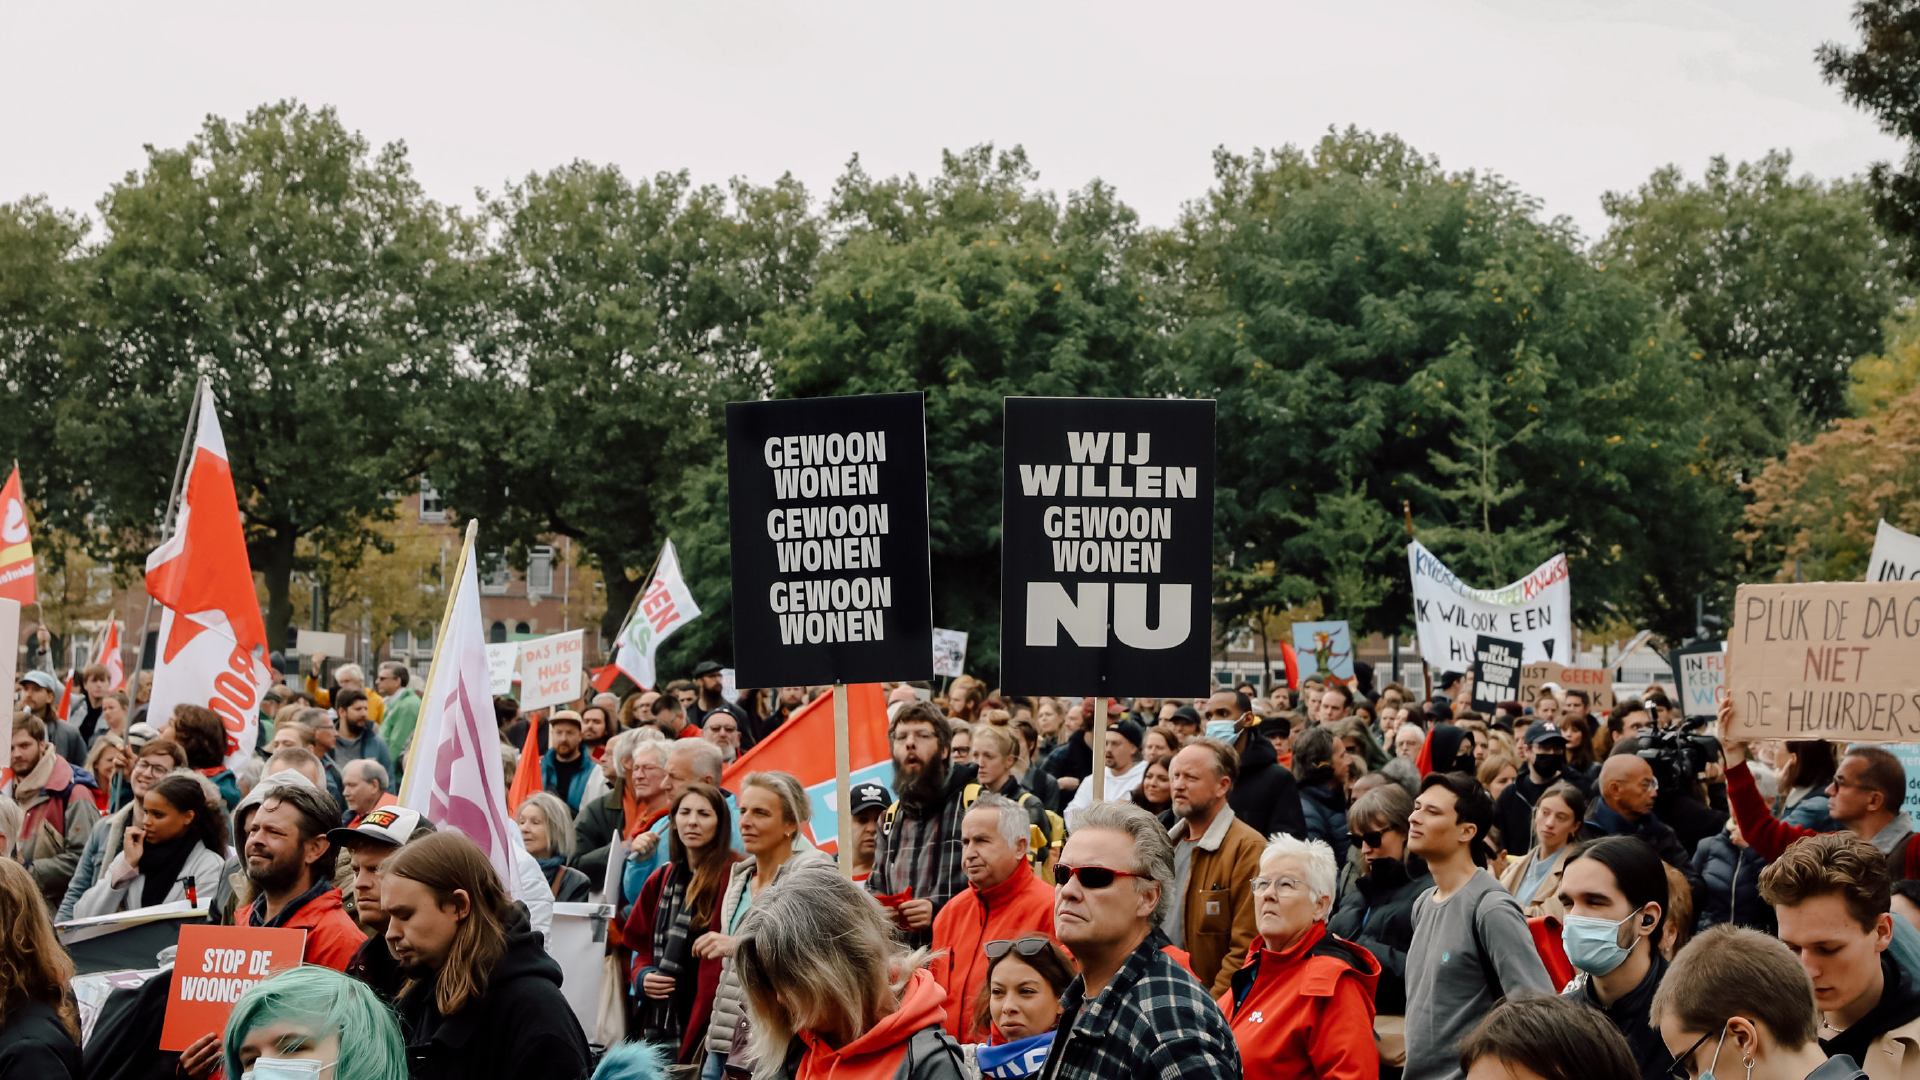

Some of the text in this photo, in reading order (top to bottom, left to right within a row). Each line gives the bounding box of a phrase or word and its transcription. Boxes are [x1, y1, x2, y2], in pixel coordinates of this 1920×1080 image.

[764, 431, 887, 468] GEWOON
[1067, 431, 1150, 465] WIJ
[773, 464, 878, 499] WONEN
[1019, 464, 1197, 498] WILLEN
[767, 503, 889, 541] GEWOON
[1043, 505, 1172, 540] GEWOON
[776, 536, 881, 573] WONEN
[1052, 540, 1161, 574] WONEN
[769, 576, 892, 613] GEWOON
[779, 609, 884, 645] WONEN
[1025, 581, 1192, 650] NU
[1416, 598, 1430, 623] IK
[1471, 613, 1498, 632] OOK
[1510, 605, 1551, 633] EEN
[1745, 596, 1920, 643] PLUK DE DAG
[526, 644, 551, 663] DAS
[538, 659, 571, 681] HUIS
[1686, 656, 1702, 672] IN
[1803, 645, 1870, 682] NIET
[540, 678, 569, 696] WEG
[1475, 681, 1516, 703] NU
[1522, 667, 1604, 684] UST GEEN
[1689, 671, 1719, 686] KEN
[1691, 685, 1725, 705] WO
[1744, 690, 1920, 736] DE HUURDERS
[202, 948, 273, 975] STOP DE
